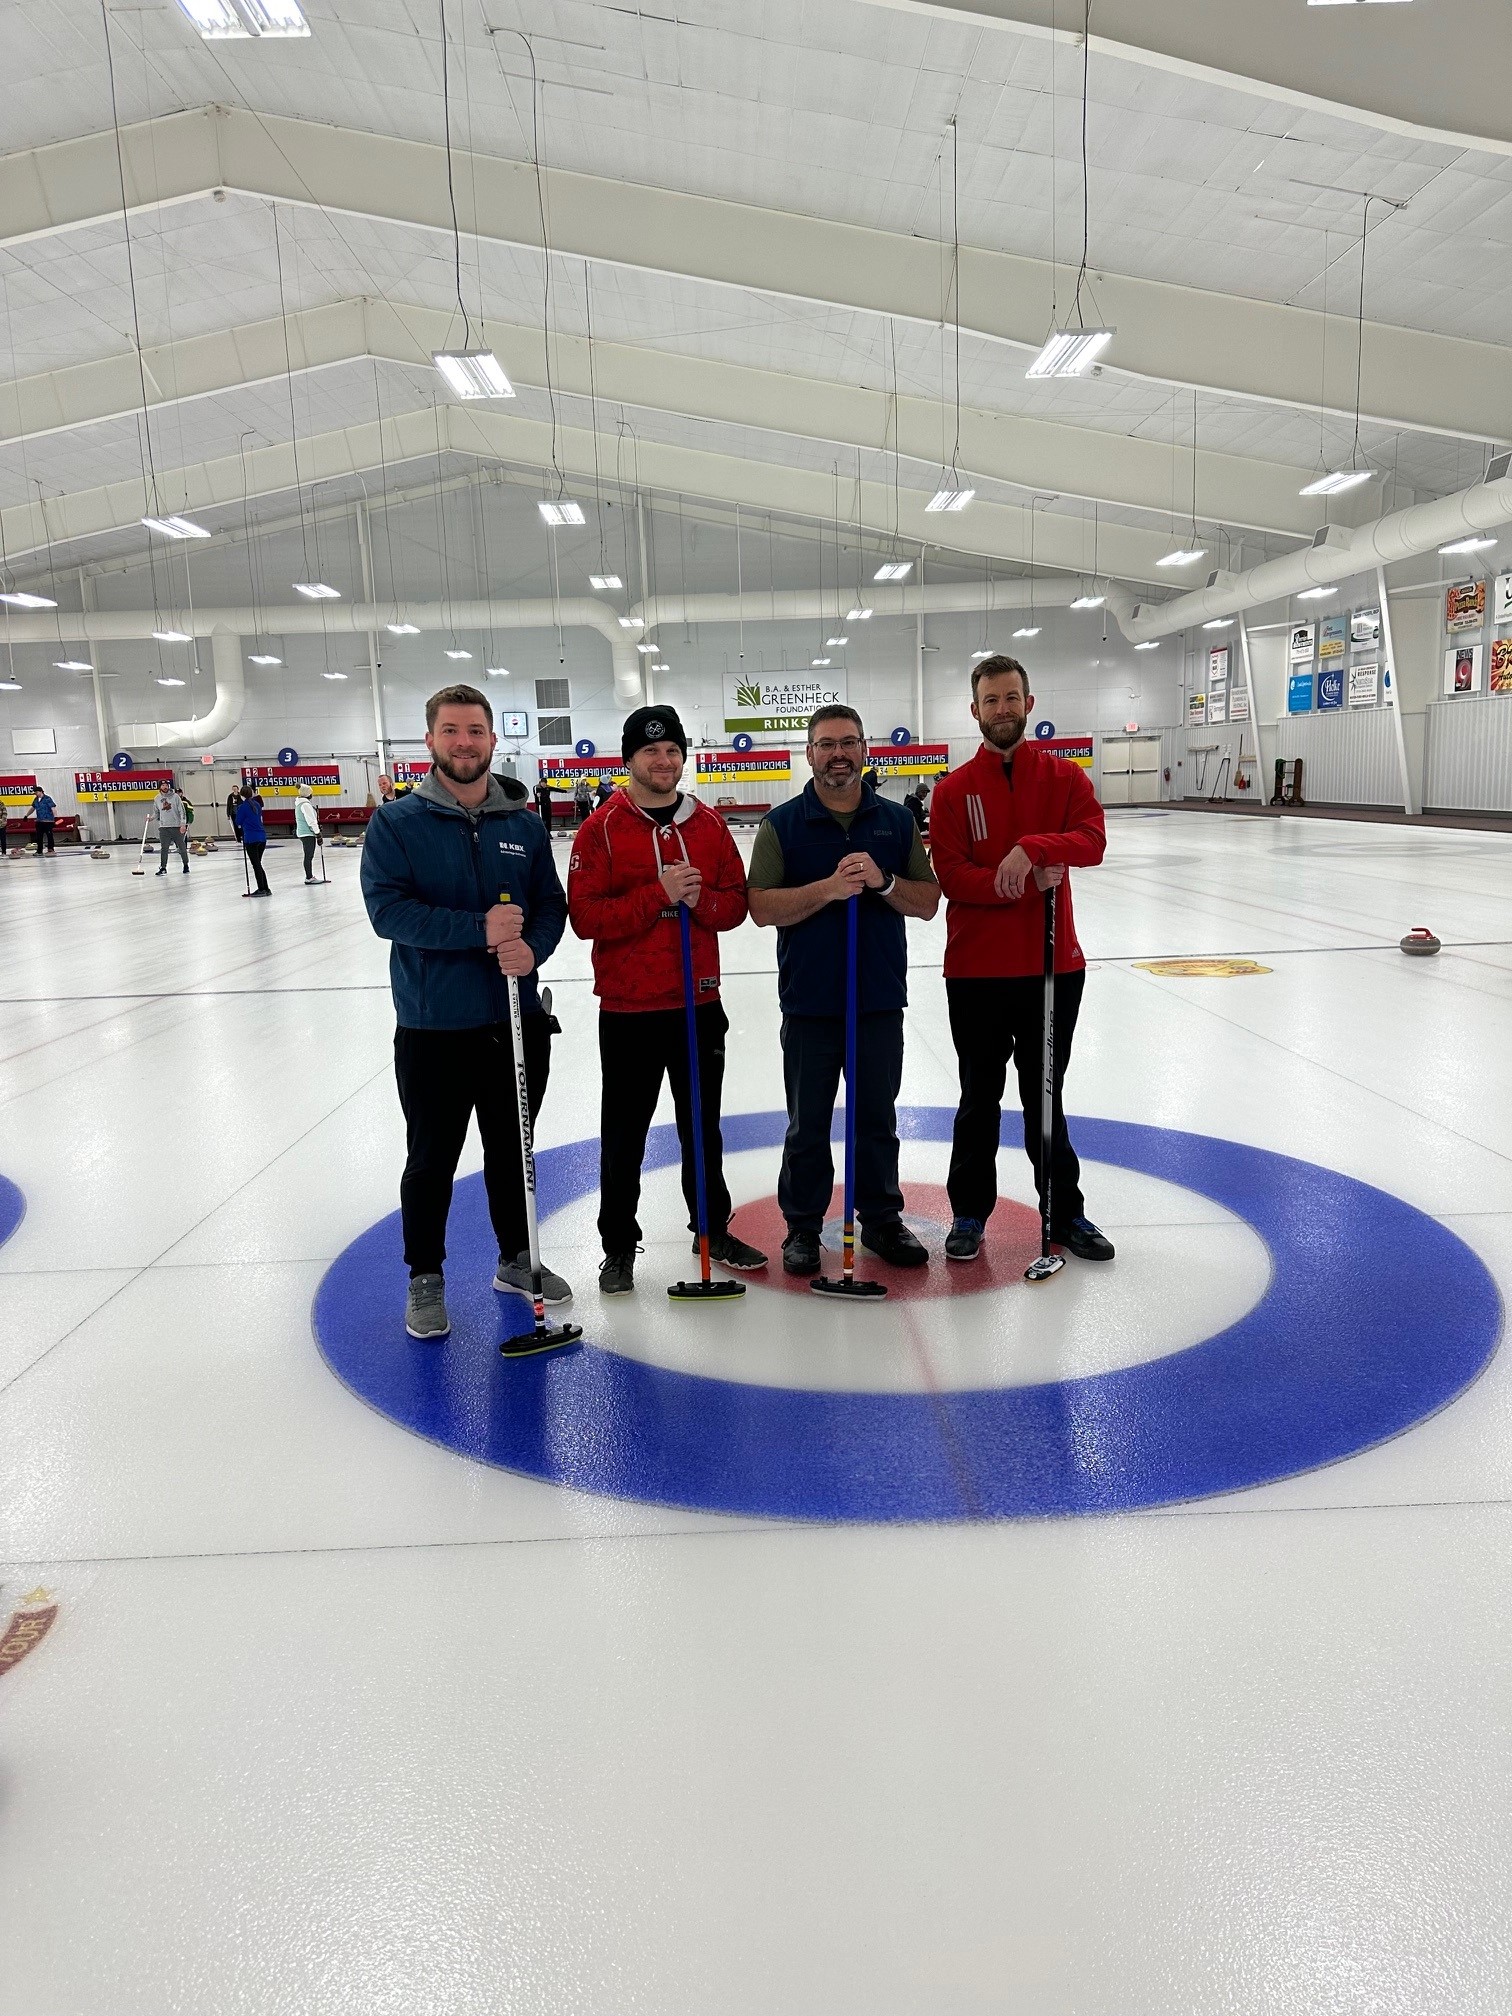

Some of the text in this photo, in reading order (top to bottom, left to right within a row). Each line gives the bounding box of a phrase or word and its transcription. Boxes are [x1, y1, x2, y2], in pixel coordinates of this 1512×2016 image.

[1457, 648, 1474, 659] NEWS
[792, 683, 821, 692] ESTHER
[761, 691, 840, 705] GREENHECK
[764, 718, 809, 729] RINKS
[1040, 726, 1049, 735] 8
[897, 732, 904, 741] 7
[738, 738, 746, 748] 6
[581, 744, 589, 753] 5
[119, 757, 126, 767] 2
[284, 753, 292, 762] 3
[658, 909, 680, 919] RIKE
[516, 1060, 535, 1195] TOURNAMENT
